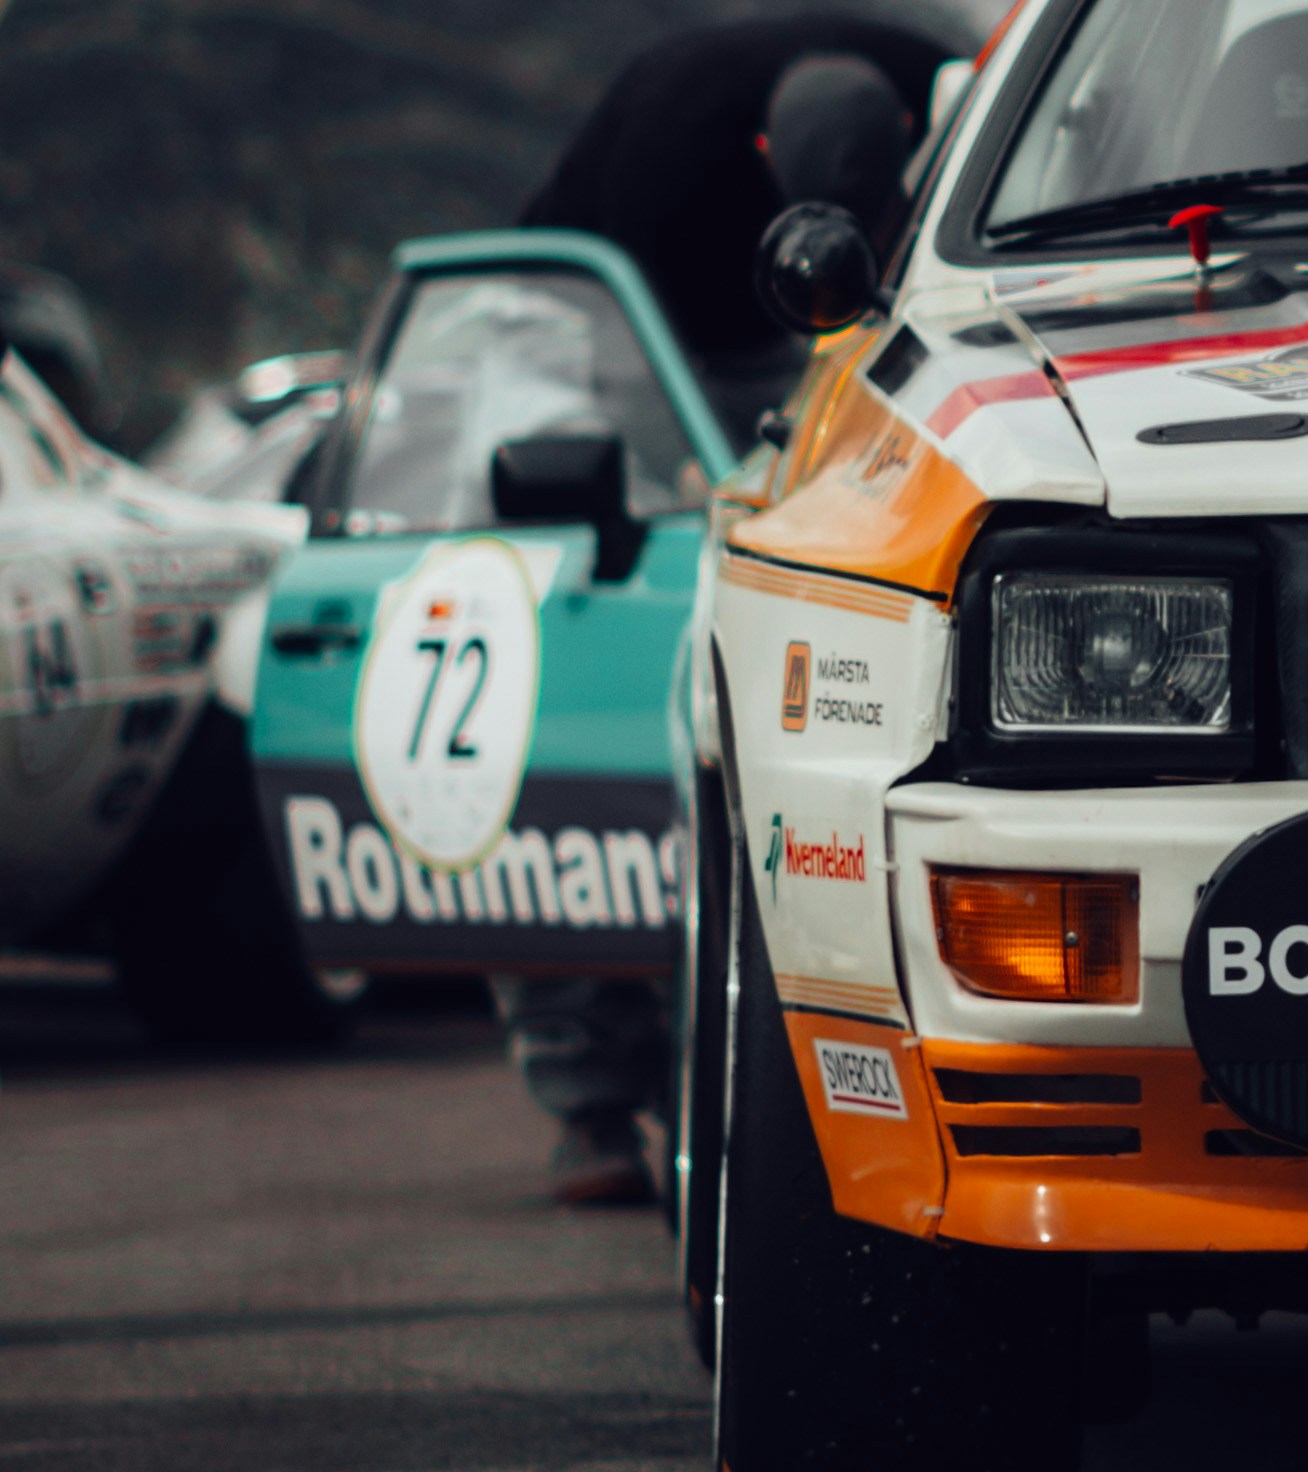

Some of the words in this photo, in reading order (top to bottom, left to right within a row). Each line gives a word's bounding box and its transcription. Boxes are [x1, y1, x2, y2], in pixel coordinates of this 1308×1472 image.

[410, 637, 489, 760] 72
[785, 826, 867, 883] Kverneland
[822, 1047, 900, 1100] SWEROCK
